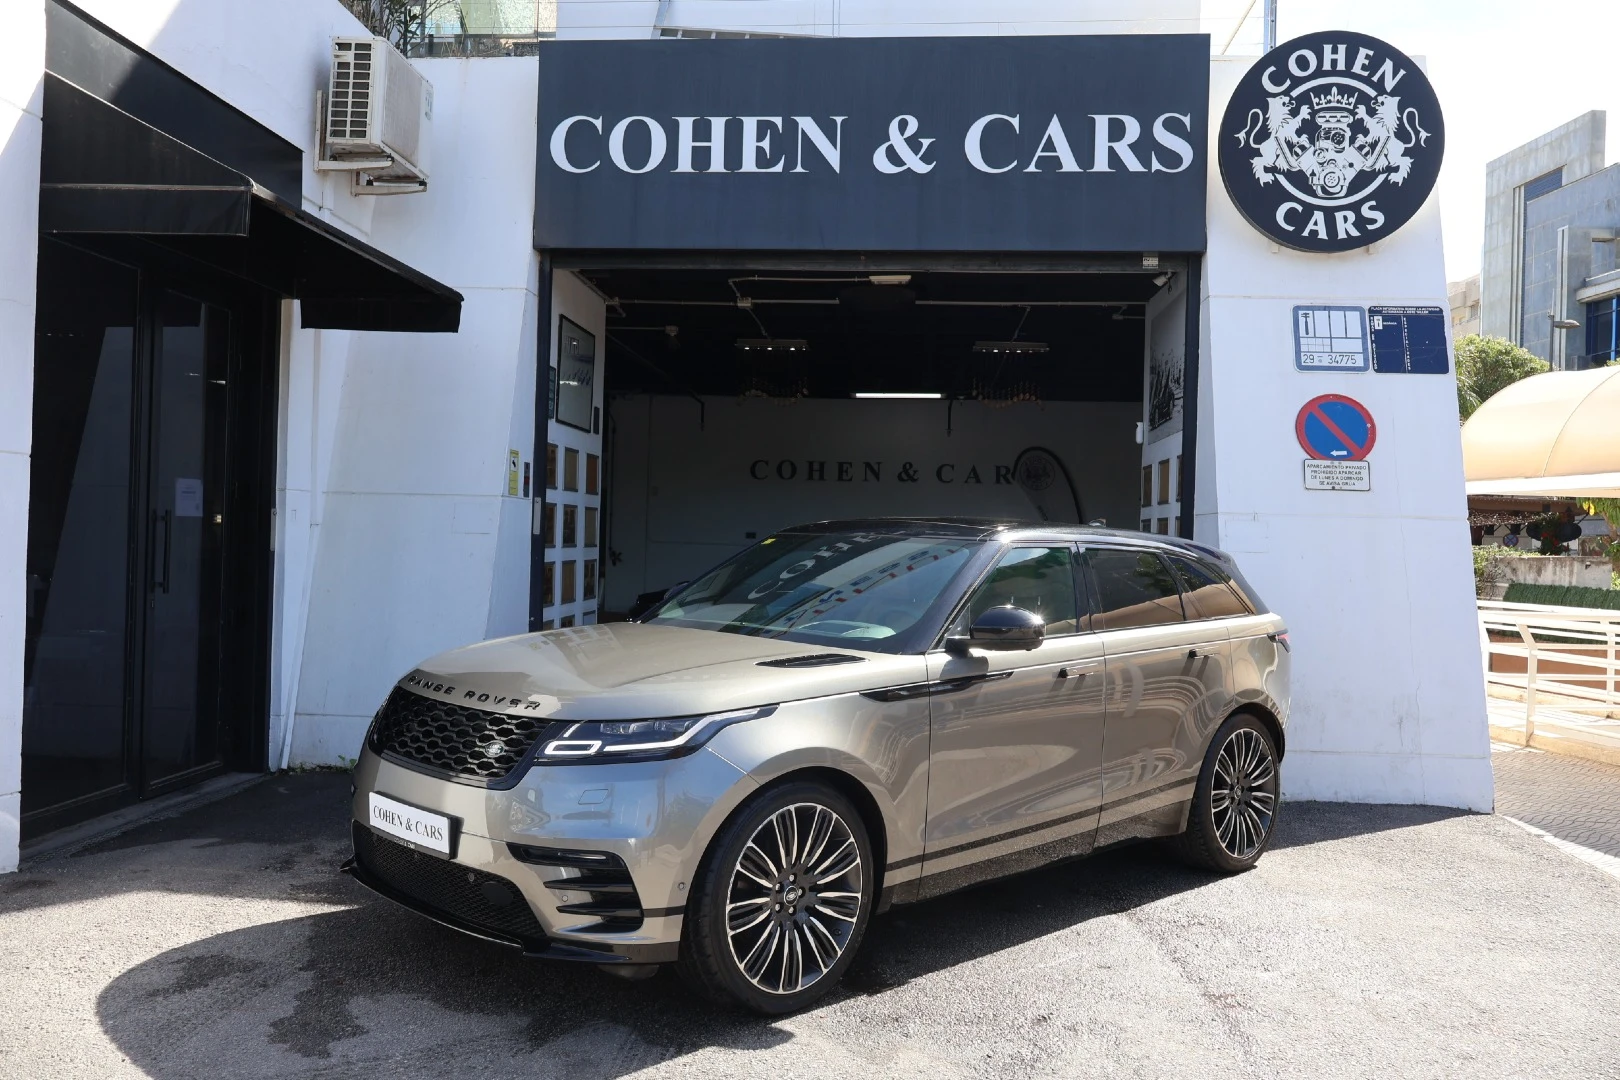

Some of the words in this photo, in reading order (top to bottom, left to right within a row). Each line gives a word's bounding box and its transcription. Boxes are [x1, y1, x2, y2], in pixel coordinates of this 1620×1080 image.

[1261, 44, 1407, 94] COHEN
[549, 114, 848, 175] COHEN
[872, 113, 937, 175] &
[964, 112, 1194, 175] CARS
[1275, 200, 1385, 240] CARS
[1303, 354, 1314, 364] 29
[1328, 354, 1357, 364] 34775
[749, 459, 883, 483] COHEN
[897, 460, 920, 483] &
[935, 463, 1013, 485] CAR
[407, 675, 456, 695] RANGE
[463, 690, 541, 710] ROVER
[373, 805, 403, 828] COHEN
[405, 817, 413, 832] &
[415, 820, 443, 842] CARS
